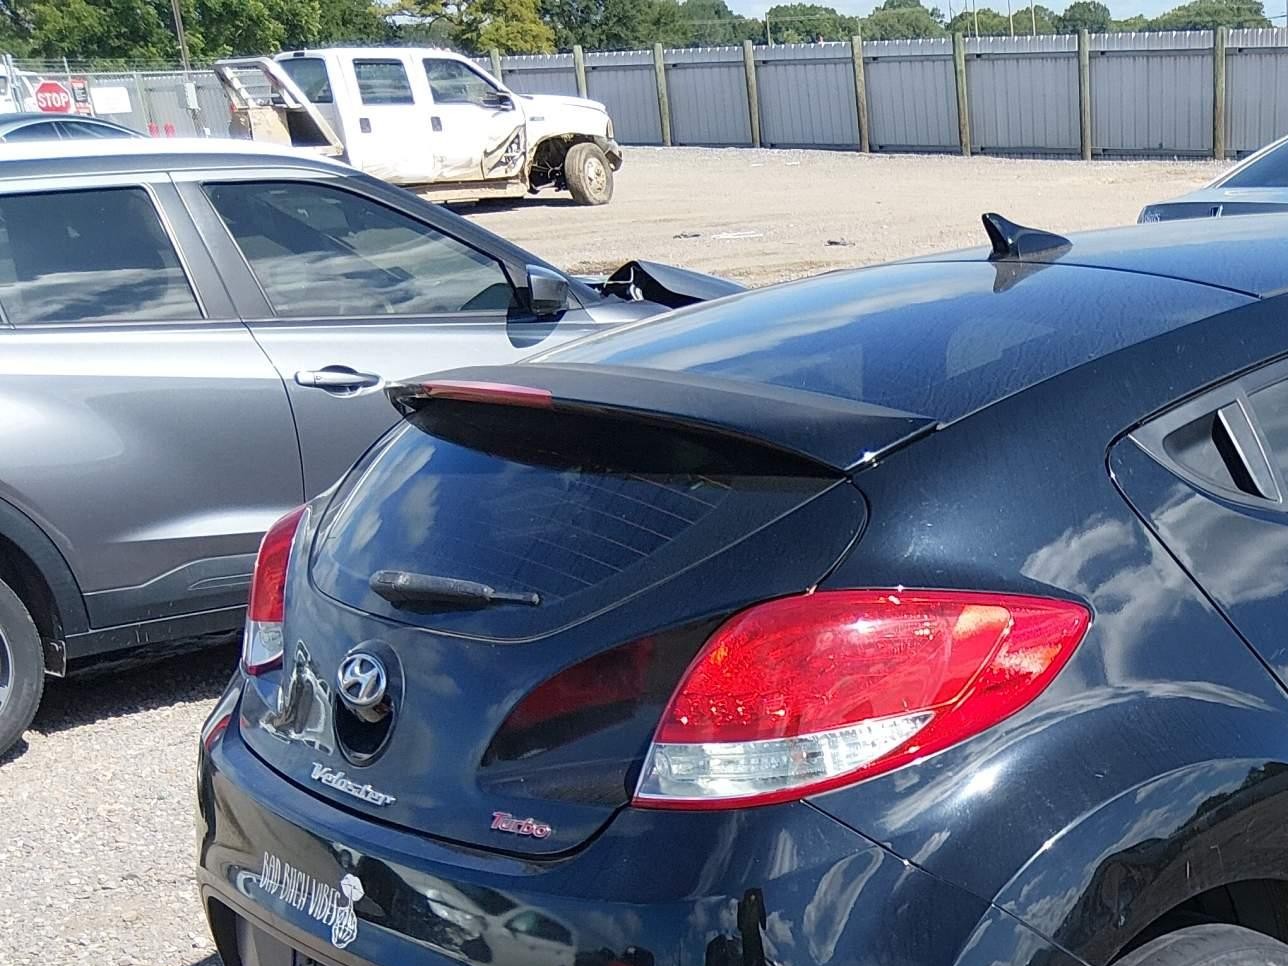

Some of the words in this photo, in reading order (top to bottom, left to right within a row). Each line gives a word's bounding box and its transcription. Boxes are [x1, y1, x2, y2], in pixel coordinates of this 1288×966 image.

[37, 92, 69, 108] STOP
[311, 762, 396, 806] Veloster
[491, 811, 552, 839] Turbo
[259, 851, 281, 895] BAD
[308, 878, 341, 926] VIBES
